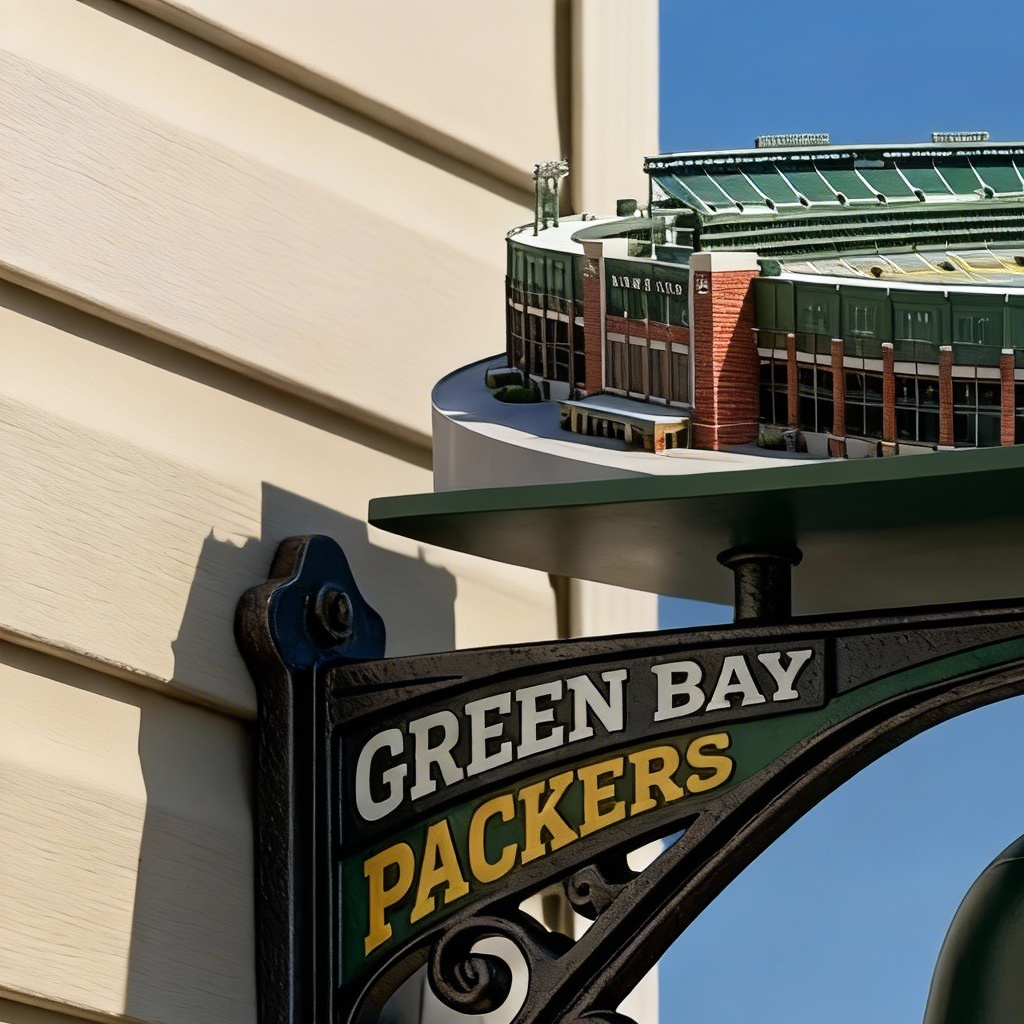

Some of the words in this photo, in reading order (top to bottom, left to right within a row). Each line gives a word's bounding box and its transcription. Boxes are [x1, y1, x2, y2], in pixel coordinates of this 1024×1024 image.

[355, 669, 628, 822] GREEN
[651, 649, 813, 722] BAY
[363, 732, 735, 957] PACKERS
